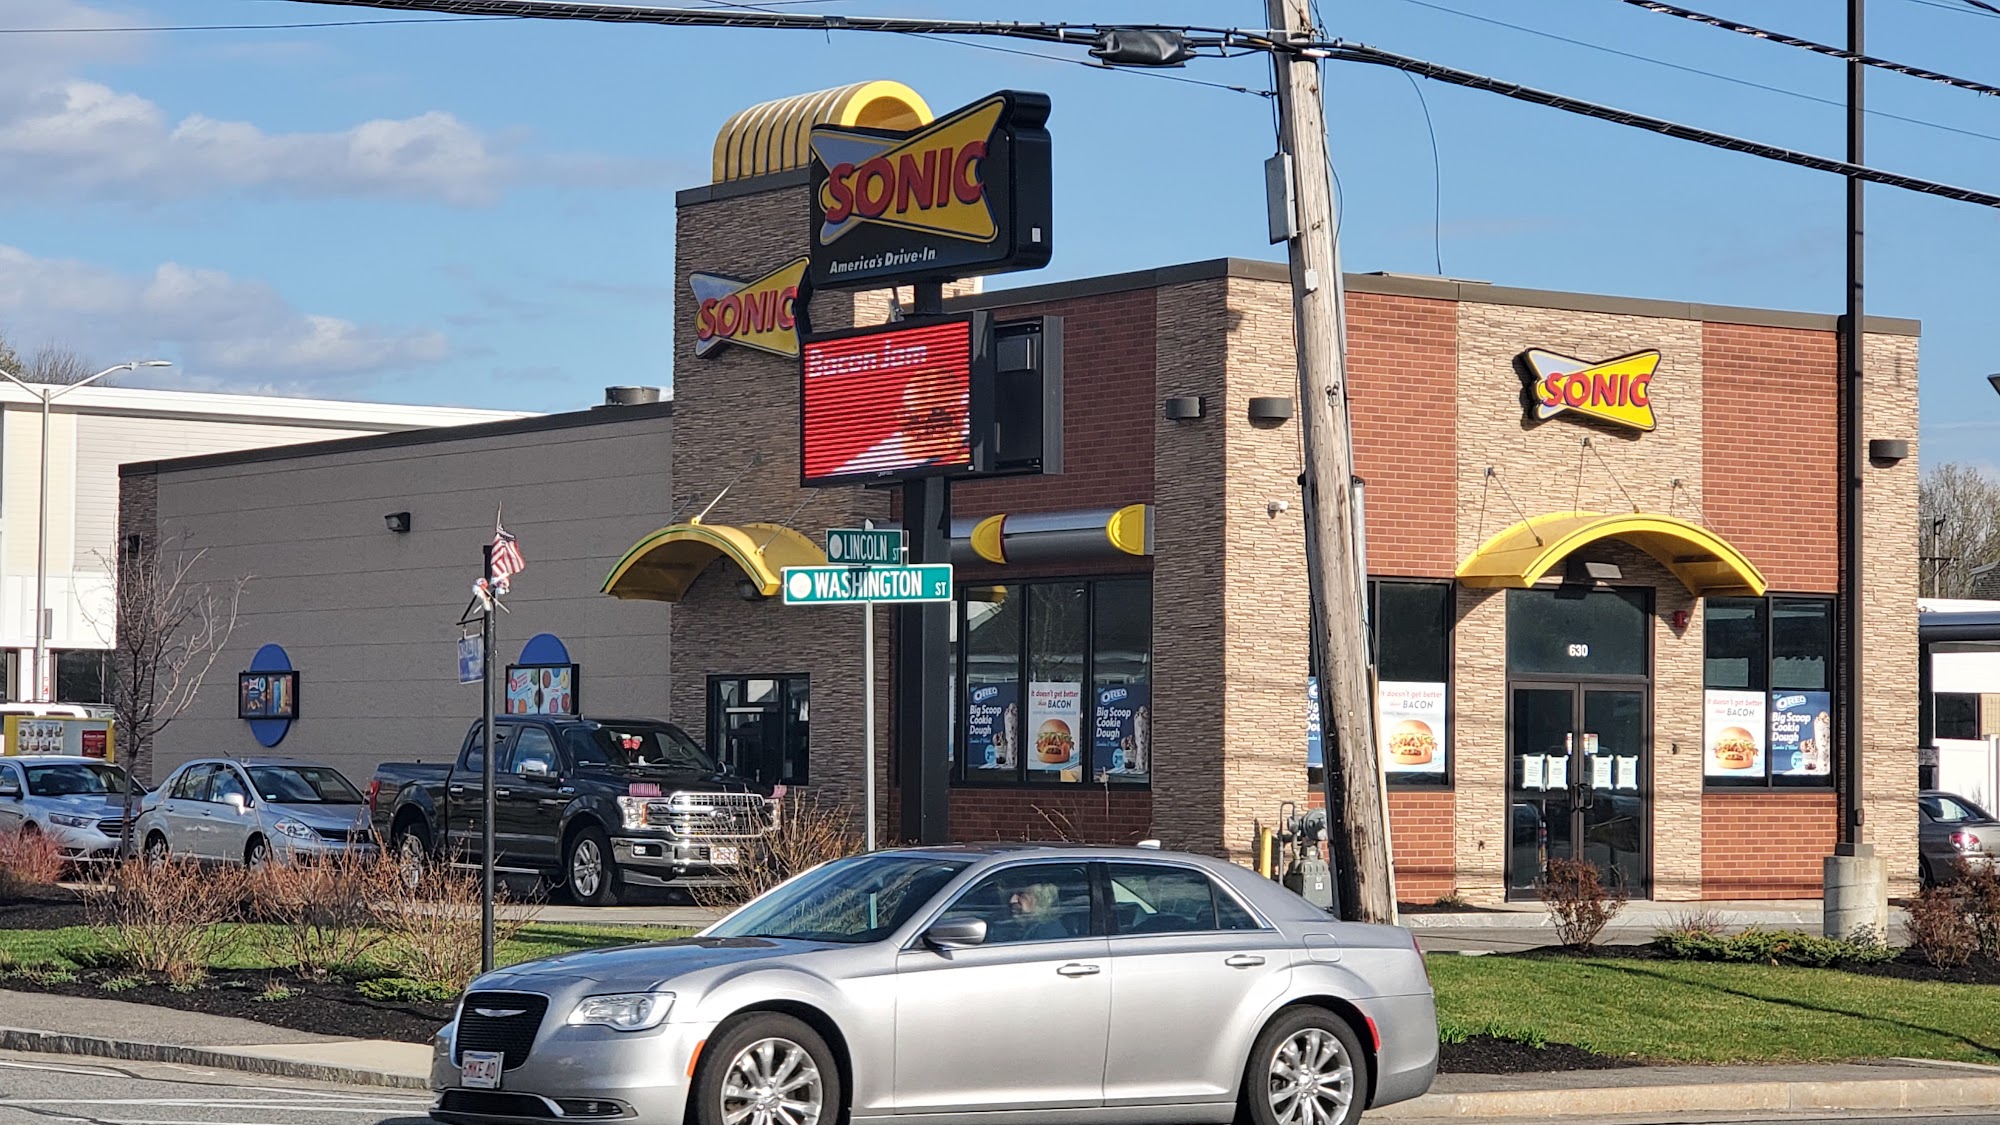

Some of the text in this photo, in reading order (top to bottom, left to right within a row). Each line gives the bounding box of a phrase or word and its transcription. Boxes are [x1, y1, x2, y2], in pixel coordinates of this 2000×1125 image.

[826, 141, 986, 224] SONIC
[829, 254, 882, 274] America's
[698, 285, 798, 341] SONIC
[1541, 372, 1651, 407] SONIC
[843, 534, 901, 561] LINCOLN ST
[814, 570, 947, 599] WASHINGTON ST
[1568, 644, 1589, 657] 630
[973, 686, 998, 703] OREO
[1063, 690, 1078, 698] better
[1101, 687, 1127, 704] OREO
[1386, 690, 1409, 698] doesn't
[1411, 690, 1422, 699] get
[969, 704, 1002, 717] Big Scoop
[1048, 699, 1072, 709] BACON
[1402, 700, 1434, 709] BACON
[969, 714, 992, 725] Cookie
[1096, 706, 1131, 720] Big Scoop
[1727, 708, 1755, 717] BACON
[1772, 711, 1786, 725] Big
[1787, 711, 1811, 725] Scoop
[1096, 717, 1121, 728] Cookie
[1772, 721, 1800, 732] Cookie
[969, 725, 992, 738] Dough
[1096, 727, 1121, 741] Dough
[1772, 731, 1800, 745] Dough
